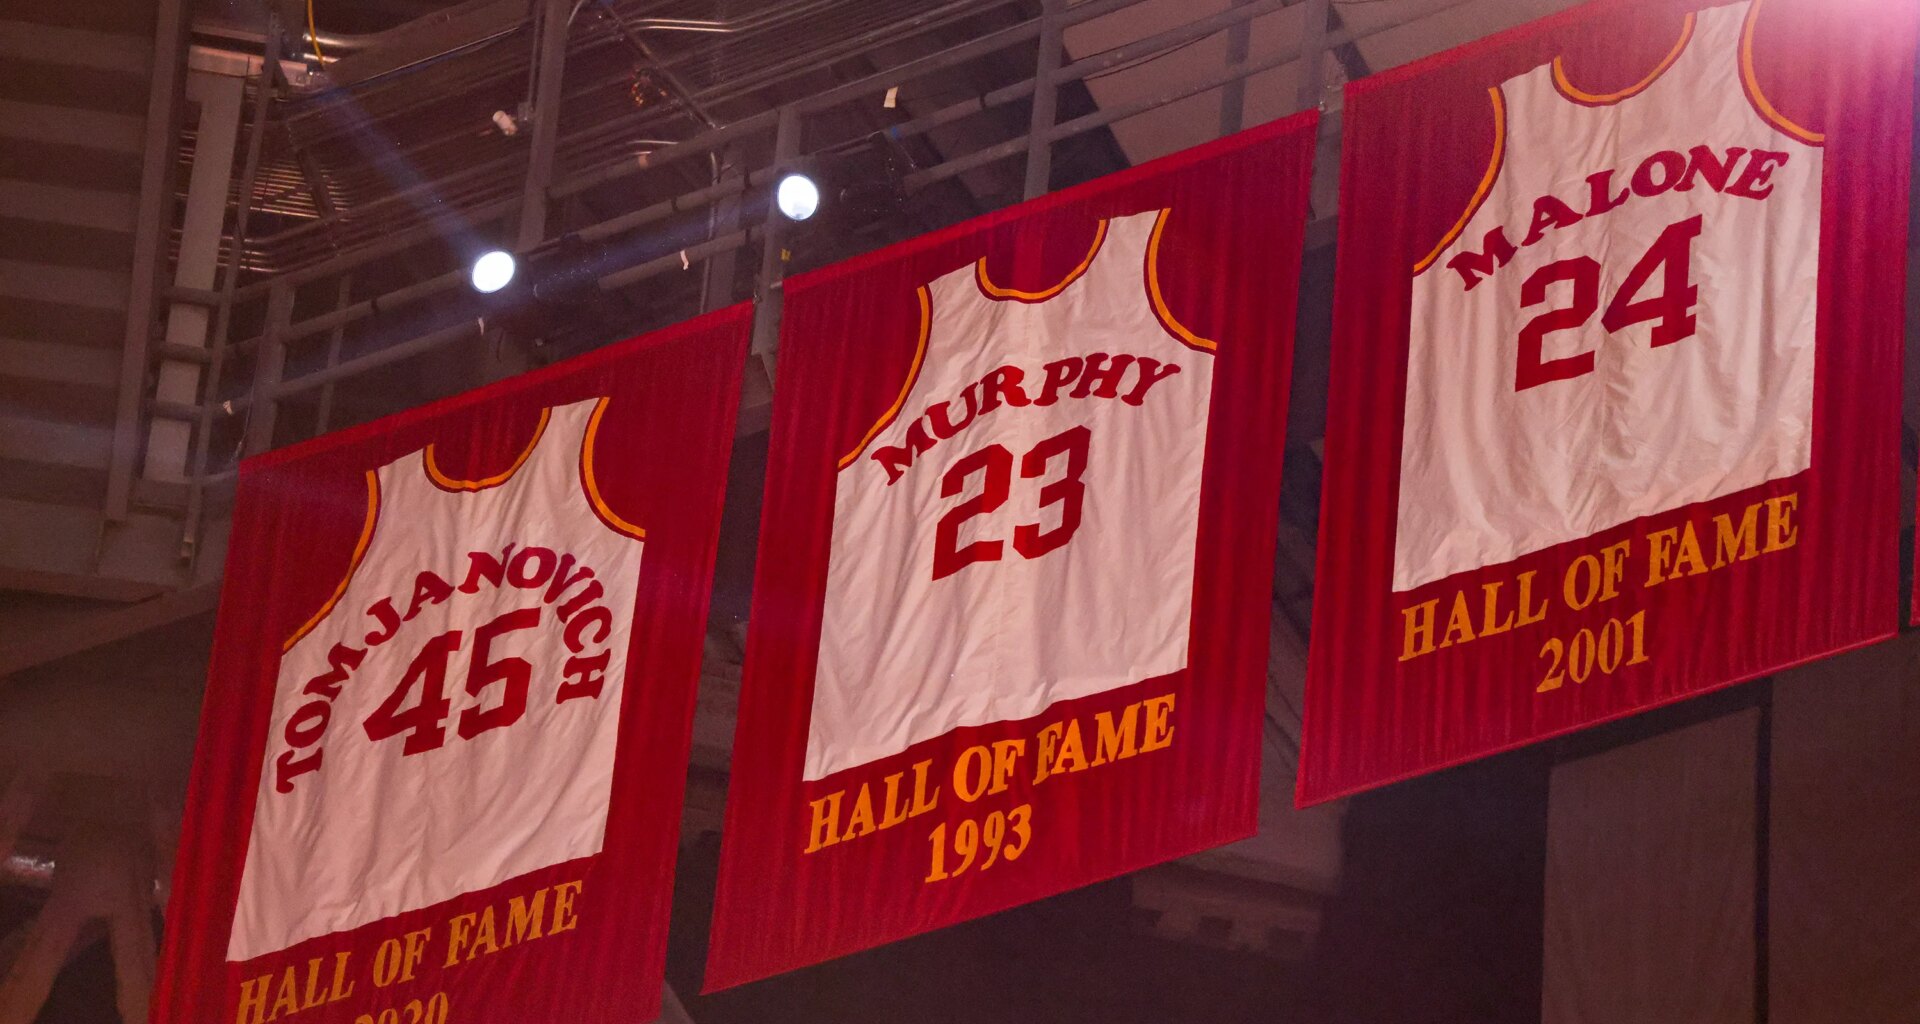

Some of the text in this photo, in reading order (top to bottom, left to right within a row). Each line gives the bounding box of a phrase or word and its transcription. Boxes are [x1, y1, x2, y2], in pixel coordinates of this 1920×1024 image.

[1446, 144, 1790, 292] MALONE
[1514, 213, 1703, 393] 24
[870, 352, 1182, 487] MURPHY
[931, 424, 1092, 582] 23
[1397, 492, 1799, 662] HALL OF FAME
[275, 541, 613, 795] TOMJANOVICH
[362, 606, 542, 757] 45
[1535, 609, 1650, 693] 2001
[803, 692, 1176, 855] HALL OF FAME
[924, 803, 1033, 884] 1993
[233, 879, 583, 1024] HALL OF FAME
